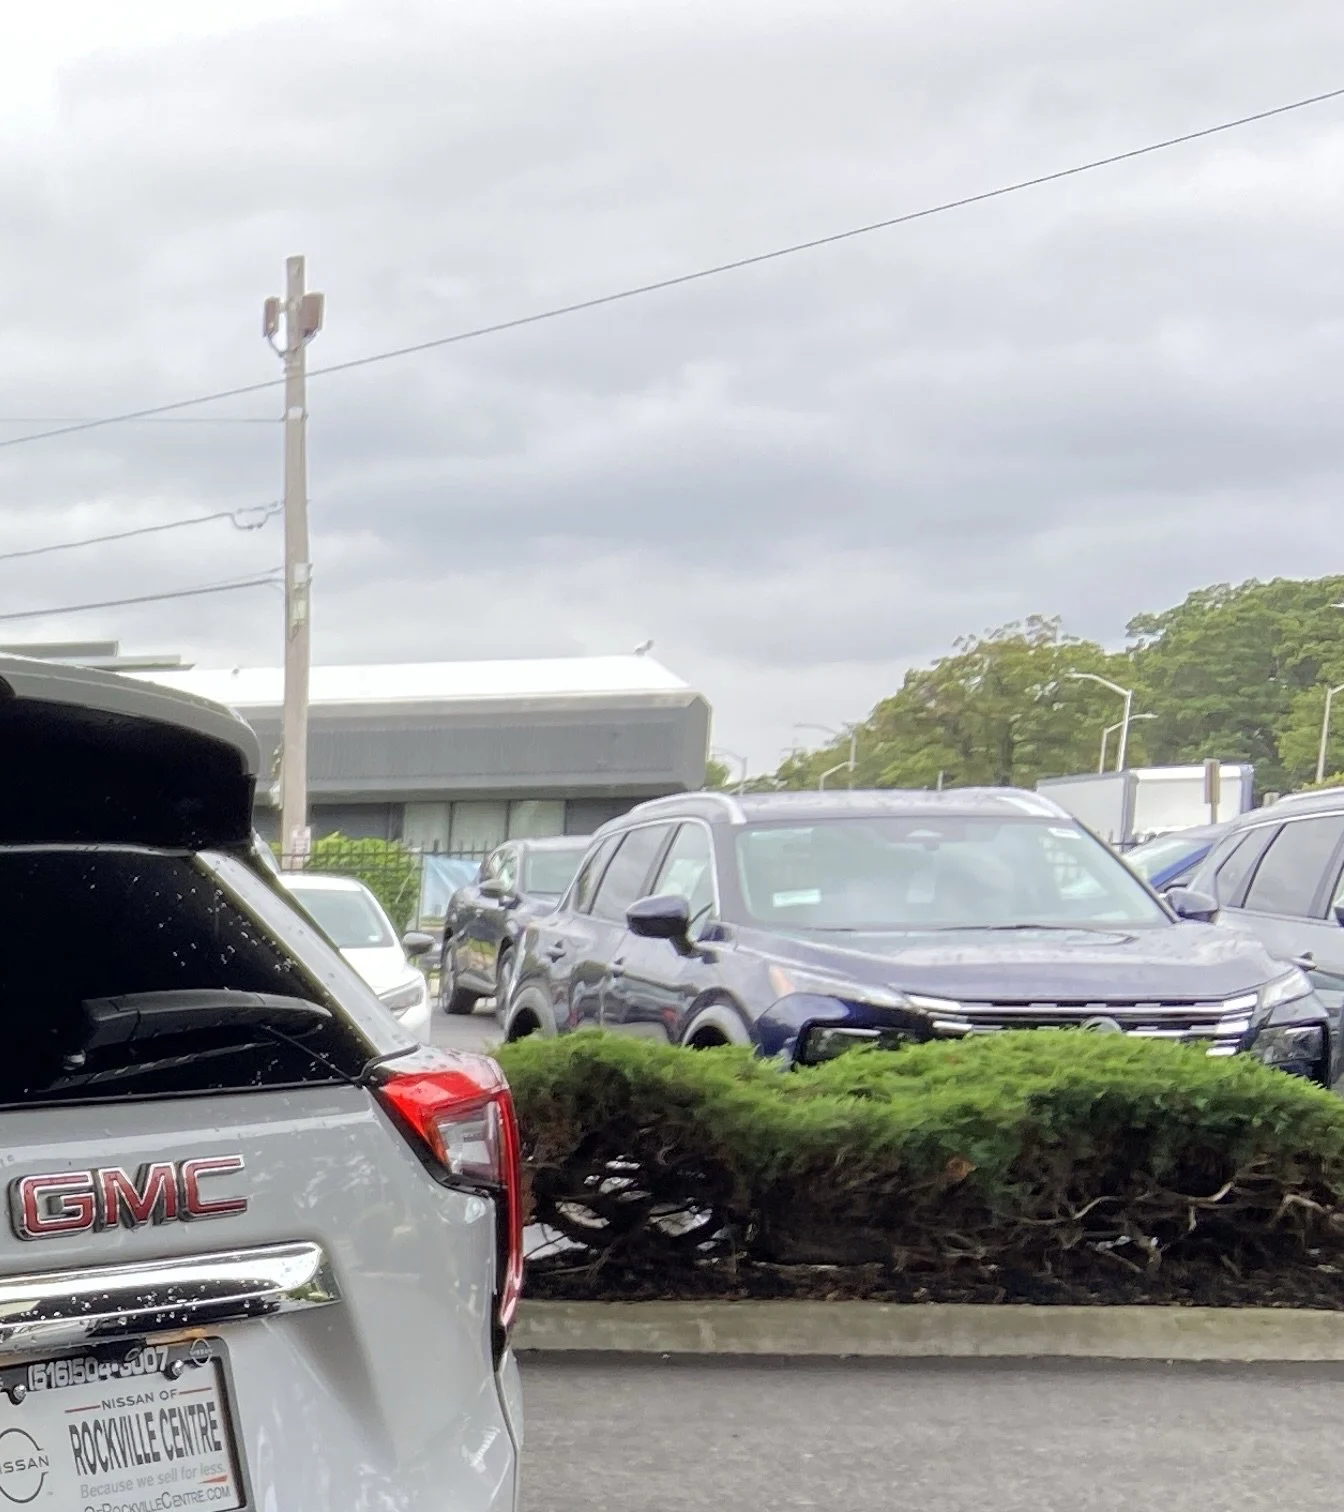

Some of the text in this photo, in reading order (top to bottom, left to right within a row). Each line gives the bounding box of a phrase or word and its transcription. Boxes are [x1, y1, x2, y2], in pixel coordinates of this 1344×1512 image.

[8, 1153, 248, 1241] GMC
[101, 1388, 179, 1411] NISSAN OF
[68, 1401, 223, 1476] ROCKVILLE CENTRE
[80, 1480, 133, 1499] Because
[136, 1476, 154, 1488] we
[157, 1467, 177, 1484] sell
[181, 1464, 197, 1480] for
